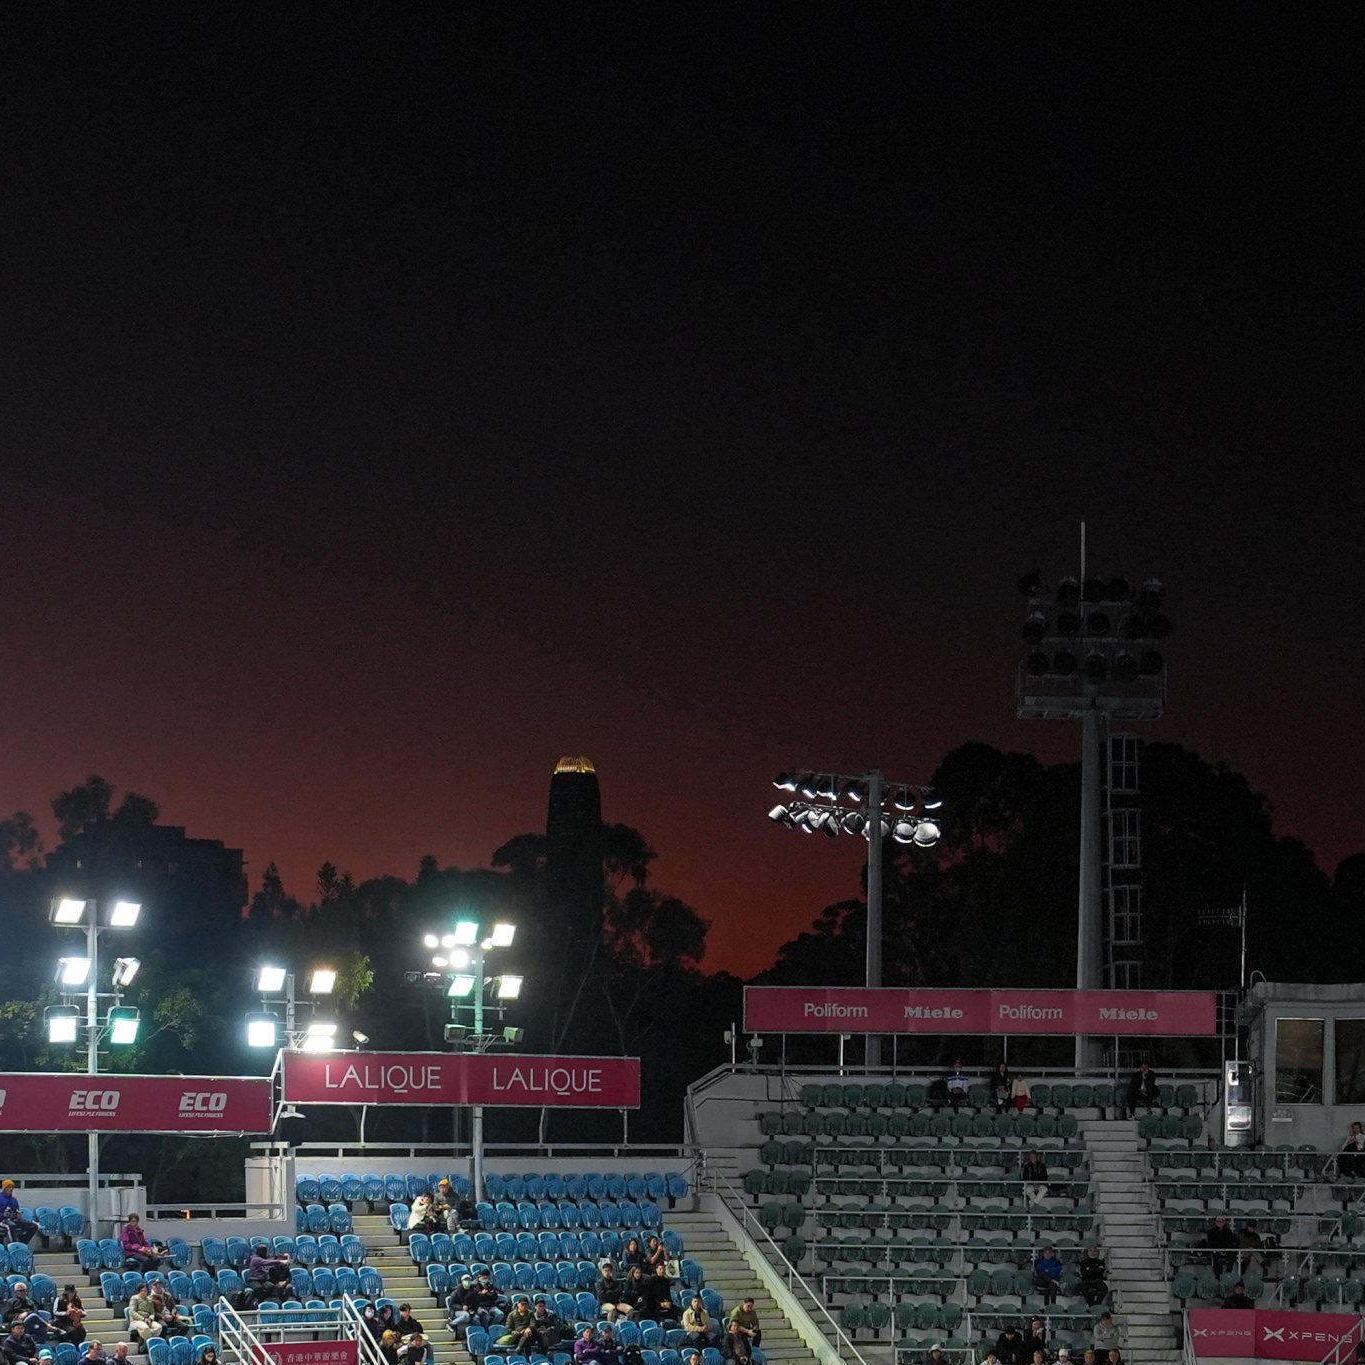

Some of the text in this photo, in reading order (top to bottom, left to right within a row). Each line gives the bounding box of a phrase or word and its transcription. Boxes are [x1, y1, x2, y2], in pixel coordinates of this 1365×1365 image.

[804, 1002, 868, 1018] Poliform
[904, 1006, 964, 1020] Miele
[999, 1003, 1063, 1020] Poliform
[1098, 1007, 1159, 1021] Miele
[325, 1065, 442, 1094] LALIQUE
[492, 1067, 603, 1096] LALIQUE
[69, 1090, 121, 1110] ECO
[178, 1092, 228, 1111] ECO
